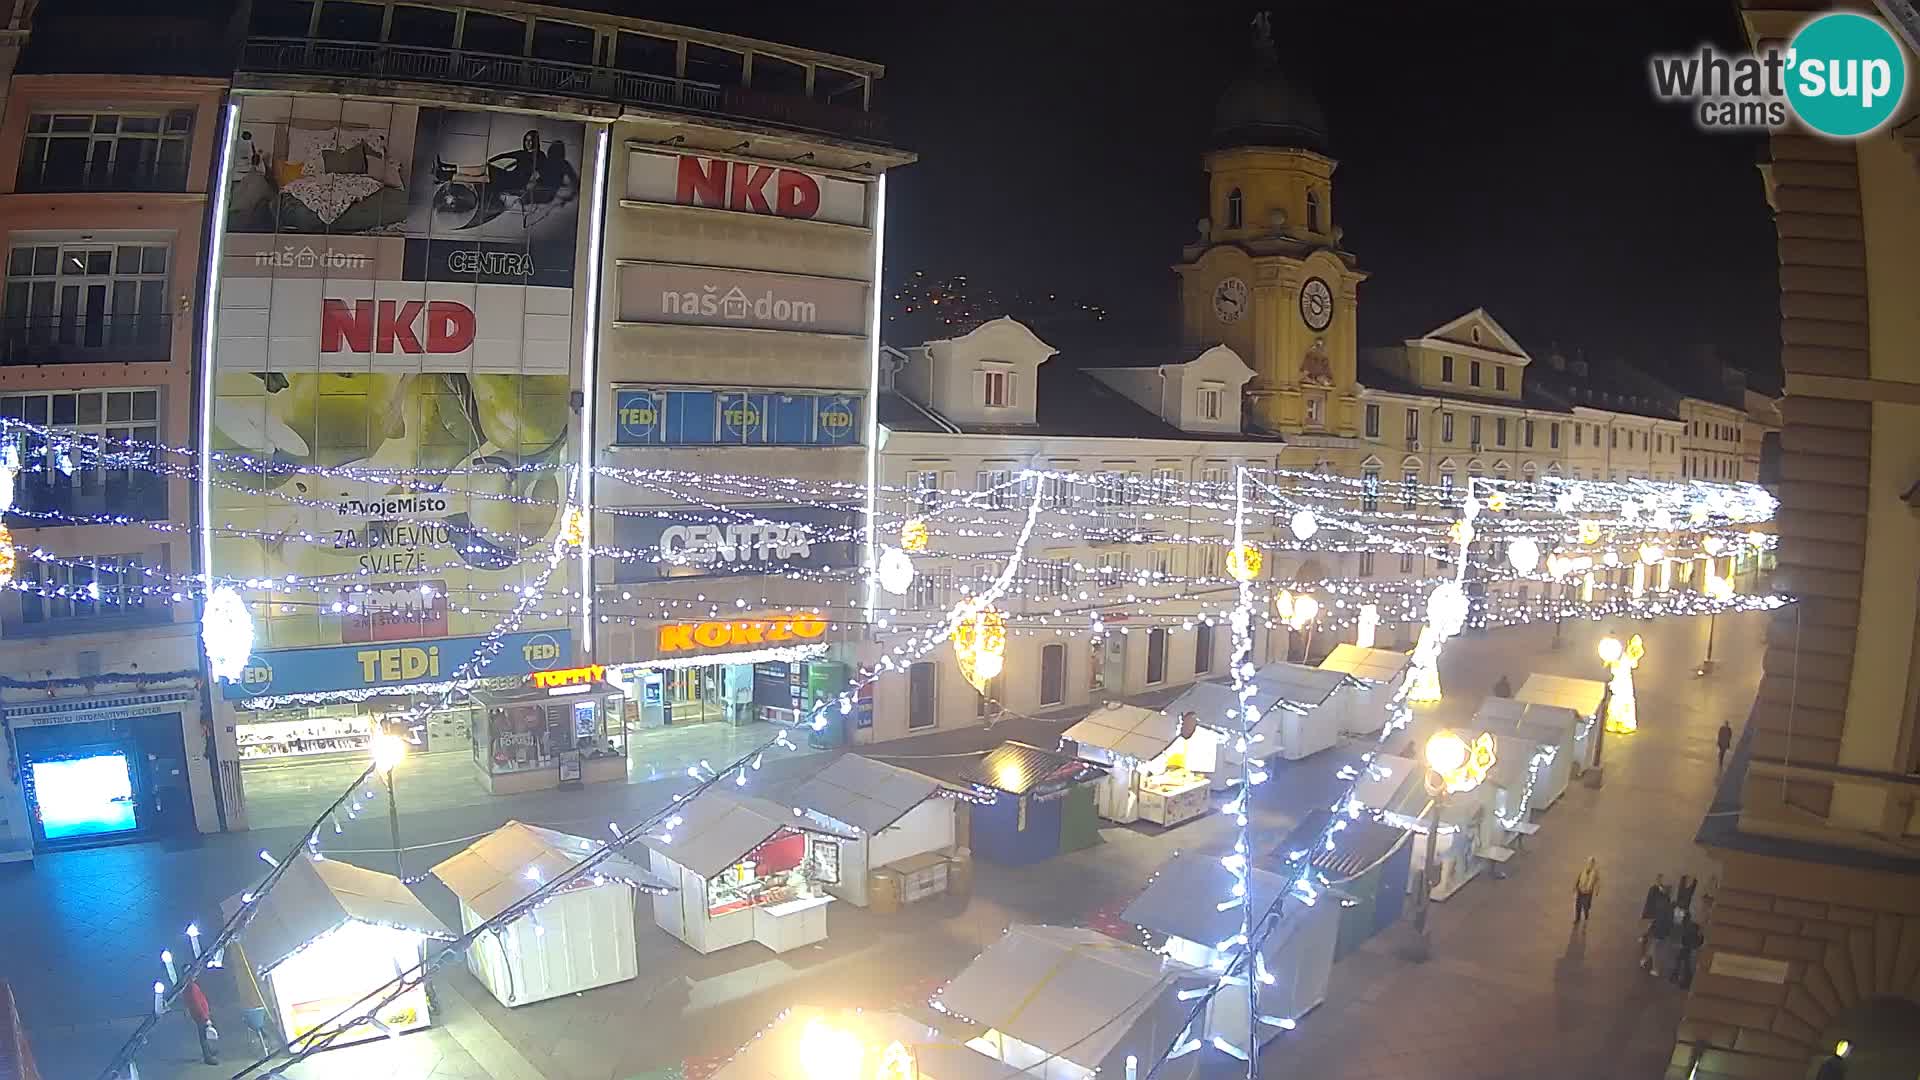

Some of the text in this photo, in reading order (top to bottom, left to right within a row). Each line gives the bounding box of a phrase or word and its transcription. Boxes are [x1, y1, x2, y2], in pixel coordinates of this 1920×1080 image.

[676, 154, 820, 219] NKD
[255, 246, 367, 268] naš dom
[448, 250, 534, 276] CENTRA
[662, 284, 816, 323] naš dom
[321, 298, 477, 354] NKD
[619, 408, 657, 425] TEDi
[724, 410, 760, 426] TEDi
[338, 497, 446, 517] #TvojeMisto
[333, 526, 450, 549] ZA DNEVNO
[660, 522, 811, 562] CENTRA
[359, 548, 426, 575] SVJEŽE
[658, 614, 828, 651] KORZO
[357, 645, 439, 684] TEDi
[522, 643, 561, 661] TEDi
[243, 666, 273, 684] EDi
[532, 664, 606, 688] TOMMY
